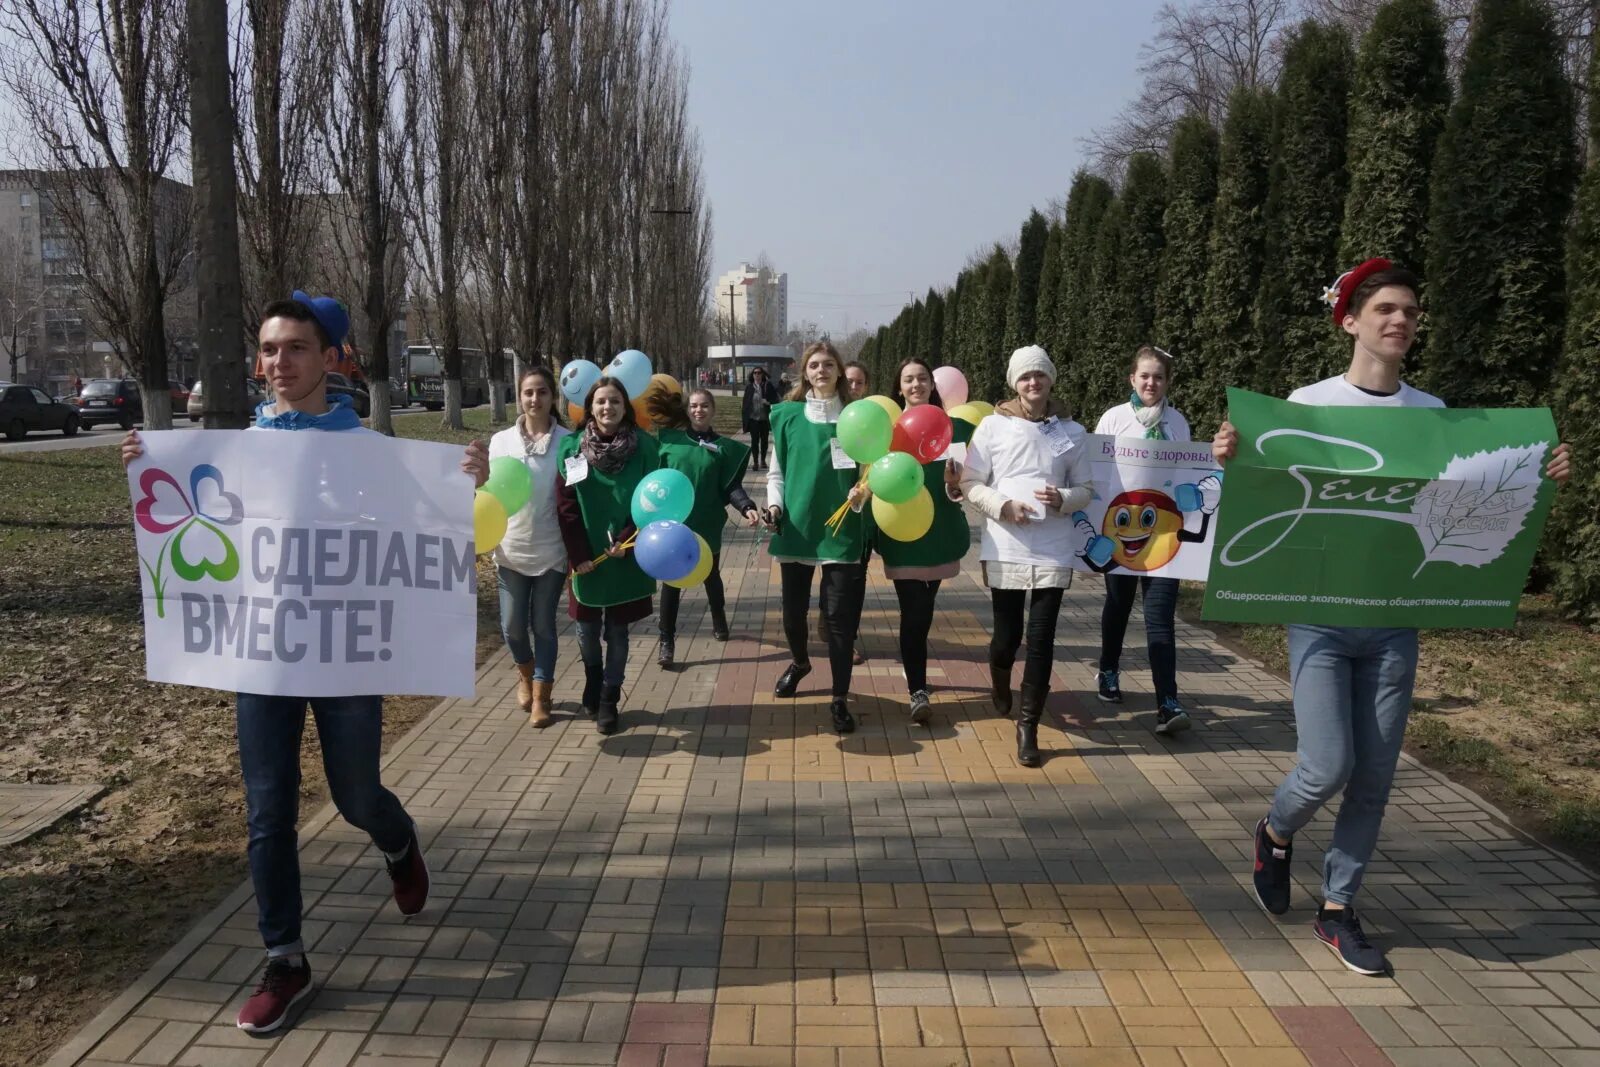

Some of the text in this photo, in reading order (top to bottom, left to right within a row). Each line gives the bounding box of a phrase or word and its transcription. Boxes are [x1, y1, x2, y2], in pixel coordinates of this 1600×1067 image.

[1102, 441, 1213, 463] Будьте здоровы!
[1425, 513, 1511, 532] РОССИЯ
[251, 525, 477, 597] СДЕЛАЕМ
[1215, 590, 1511, 607] Общероссийское экологическое общественное движение
[180, 591, 395, 664] ВМЕСТЕ!
